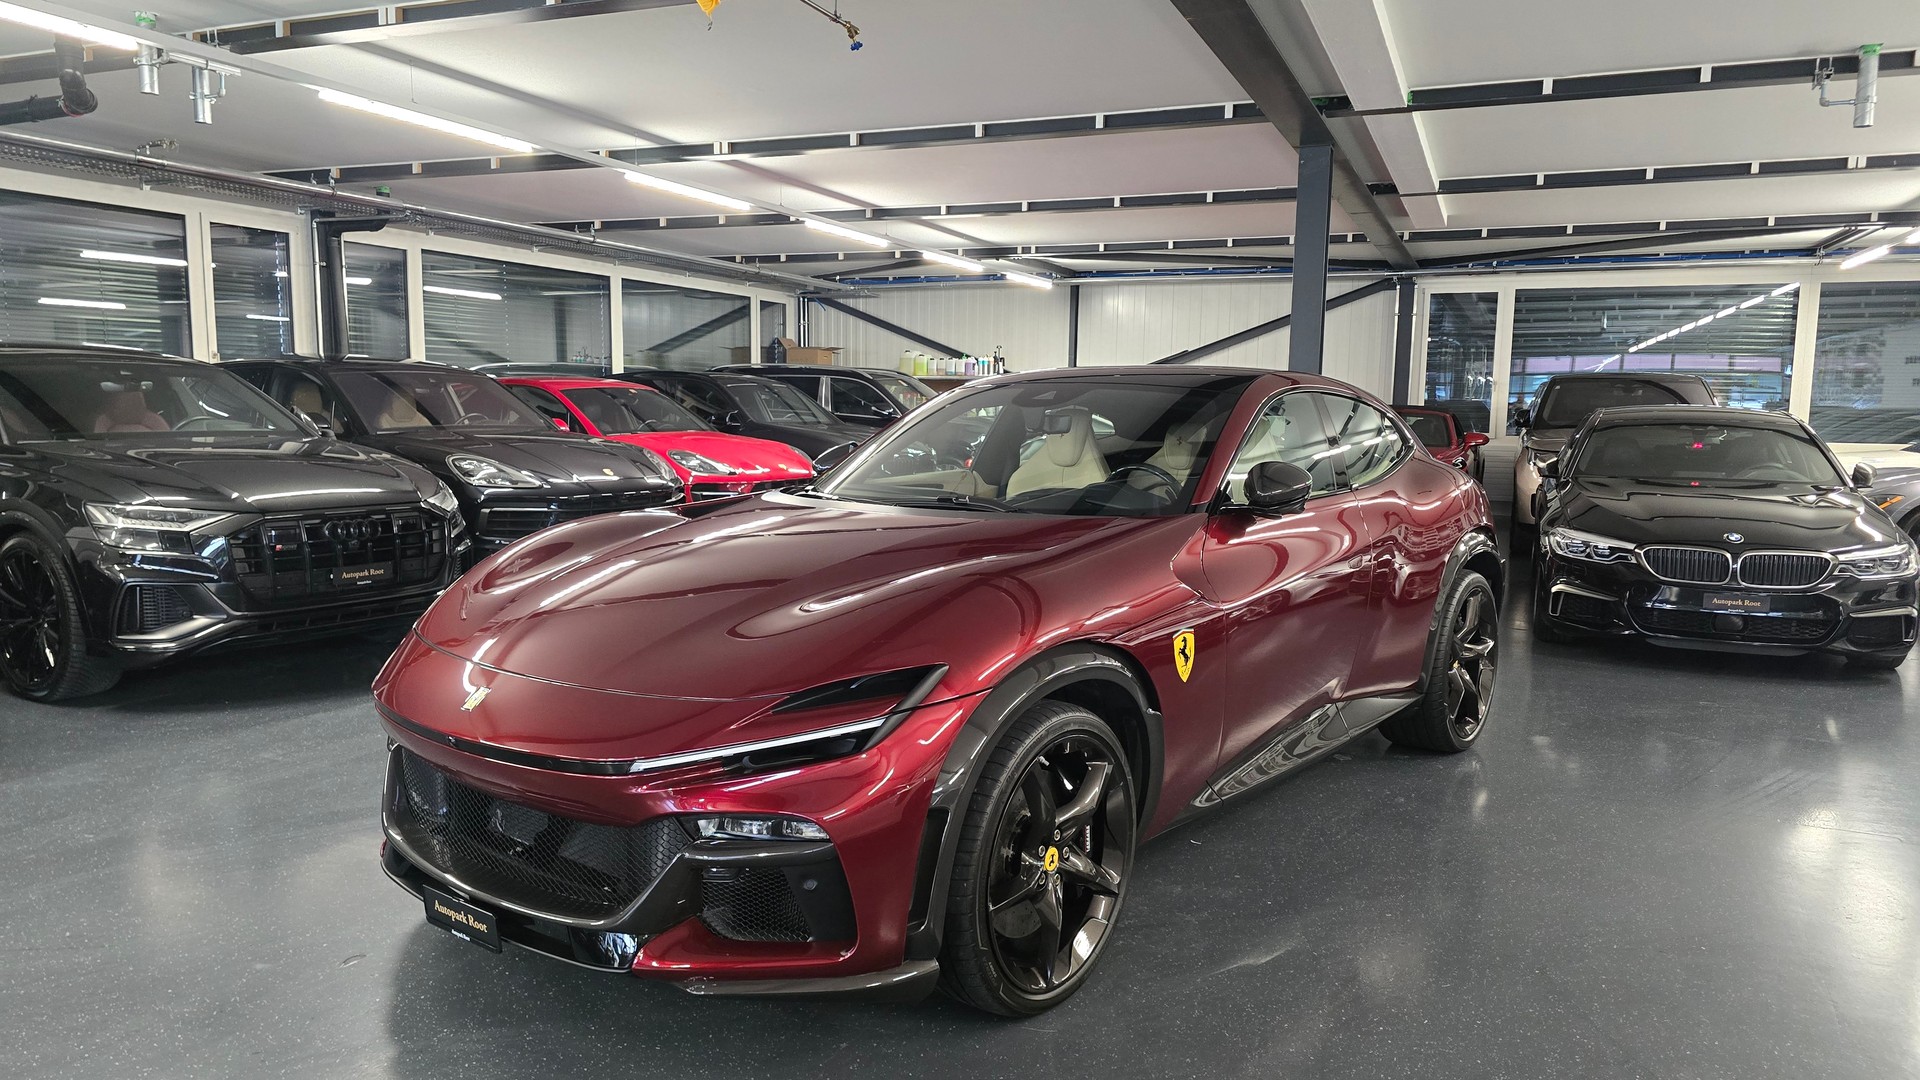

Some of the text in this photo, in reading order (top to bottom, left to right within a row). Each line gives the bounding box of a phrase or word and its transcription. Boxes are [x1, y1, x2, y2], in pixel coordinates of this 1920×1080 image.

[342, 568, 384, 579] Autopark Root
[1712, 597, 1761, 607] Autopark Root
[434, 899, 488, 933] Autopark Root
